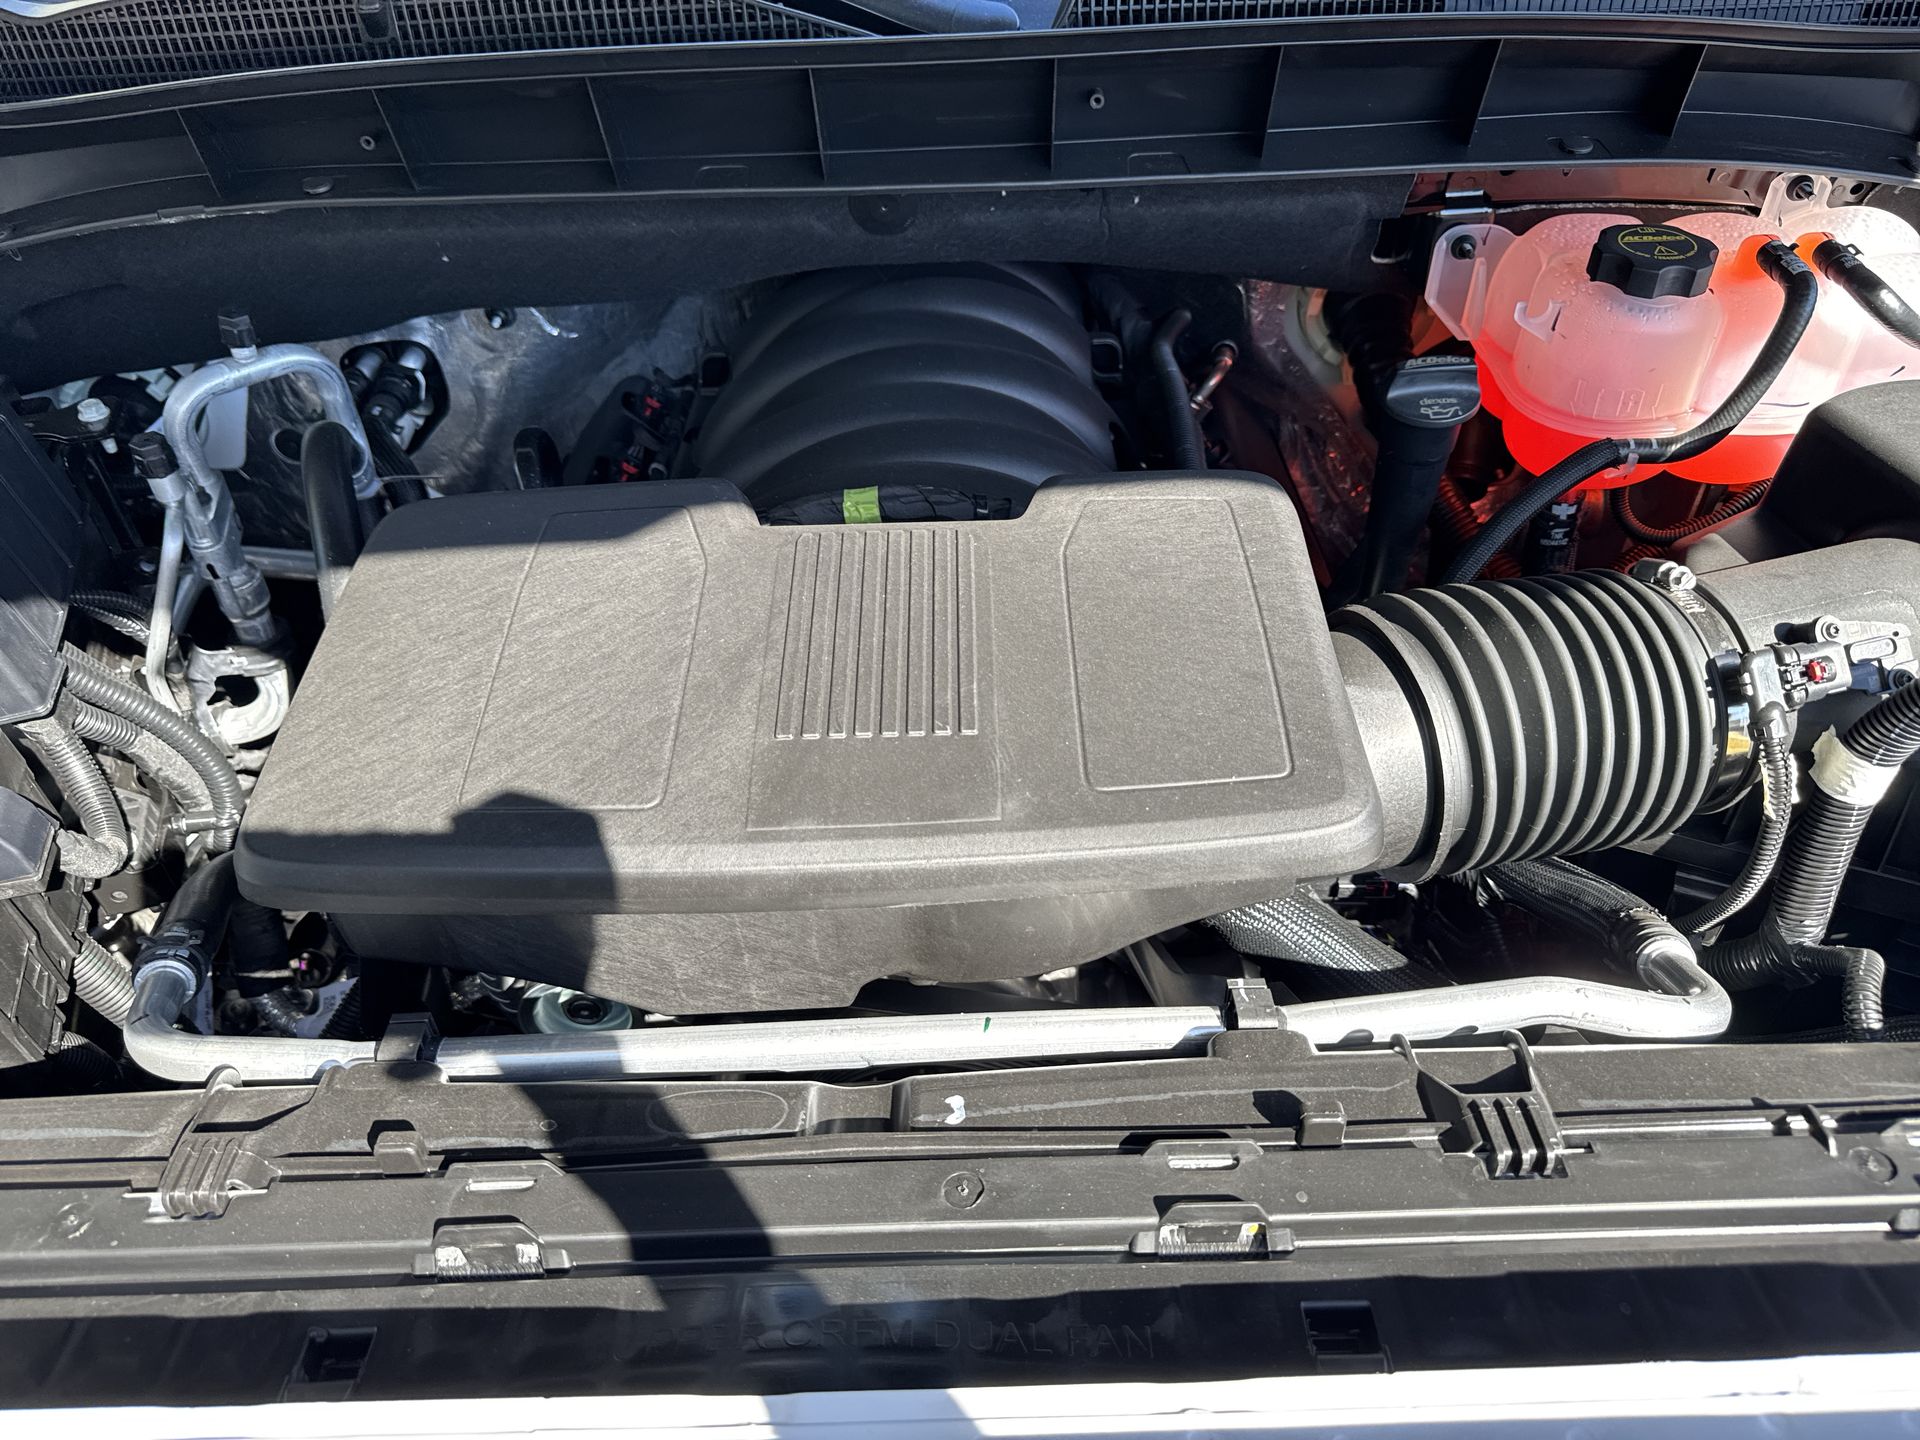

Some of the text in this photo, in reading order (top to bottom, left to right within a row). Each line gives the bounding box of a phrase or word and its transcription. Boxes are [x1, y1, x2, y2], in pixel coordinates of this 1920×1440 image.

[1621, 233, 1686, 242] ACDelco
[1404, 355, 1471, 369] ACDelco
[935, 1319, 1054, 1355] DUAL
[1065, 1322, 1155, 1360] FAN
